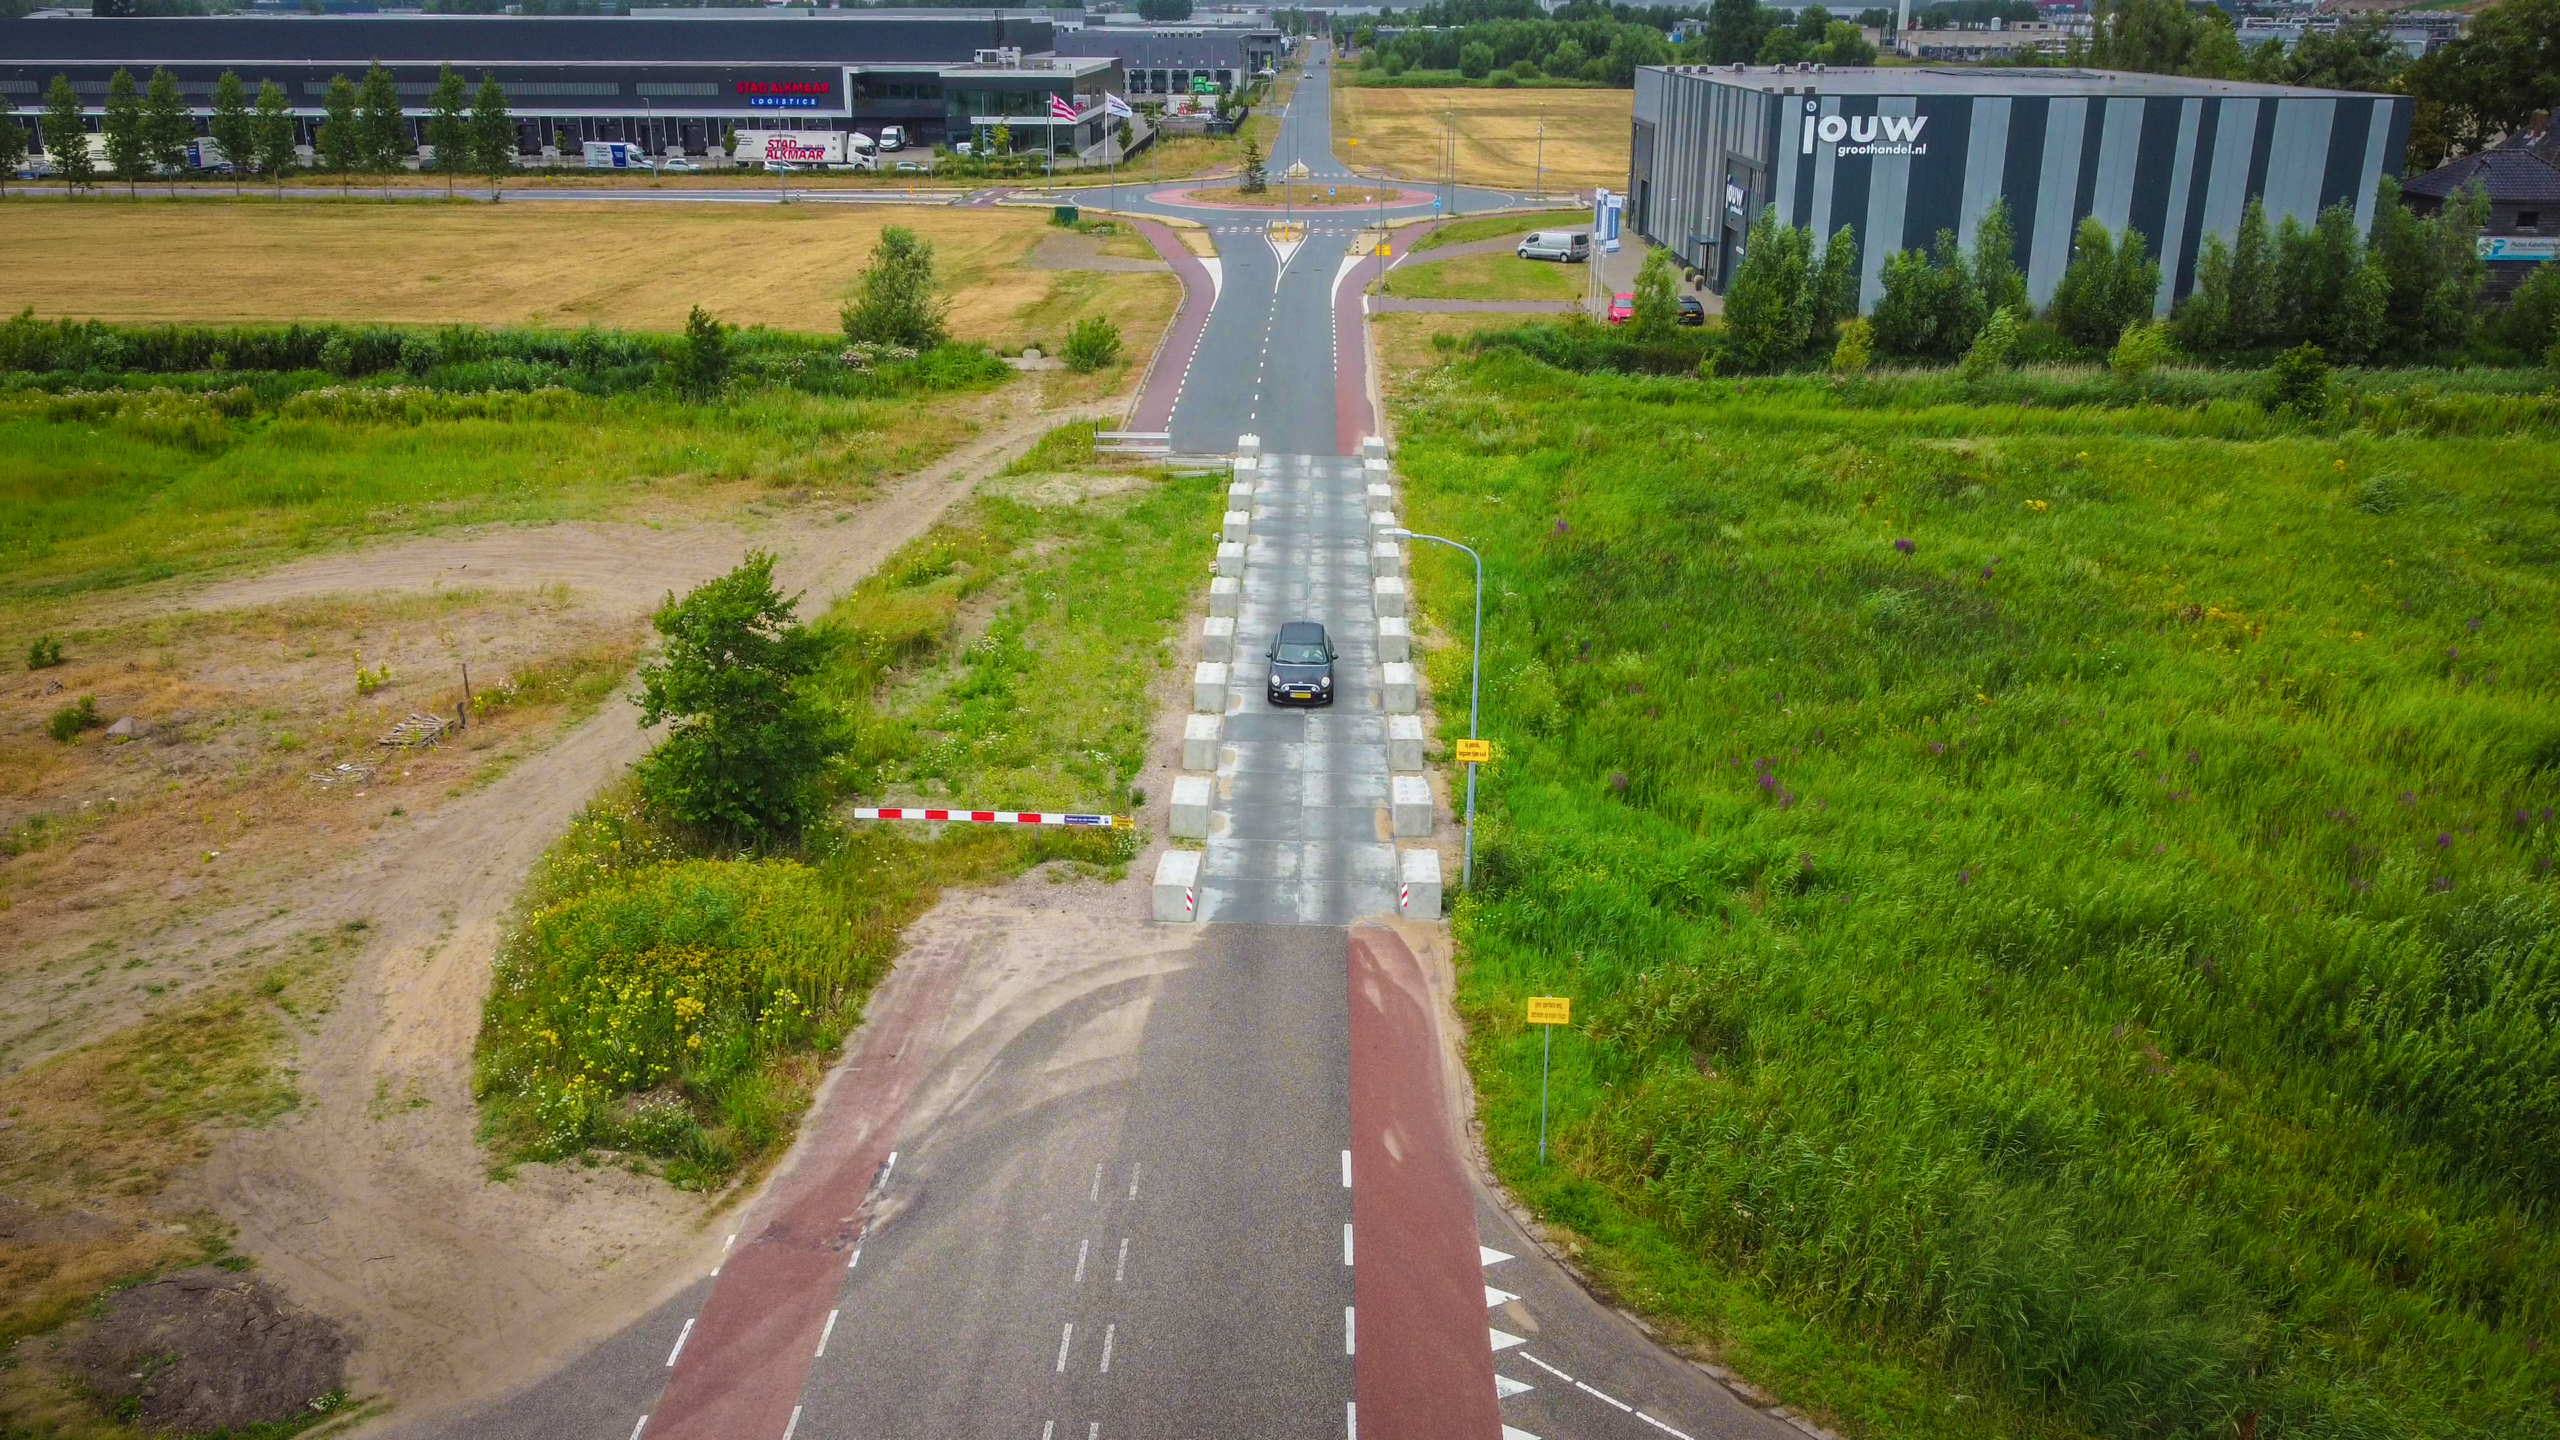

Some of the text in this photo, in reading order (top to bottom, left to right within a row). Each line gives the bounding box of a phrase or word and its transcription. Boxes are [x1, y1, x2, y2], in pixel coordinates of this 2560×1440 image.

[736, 82, 830, 94] STAD ALKMAAR
[1802, 100, 1929, 154] jouw
[767, 139, 798, 149] STAD
[1838, 143, 1927, 157] groothandel.nl
[765, 150, 826, 161] ALKMAAR
